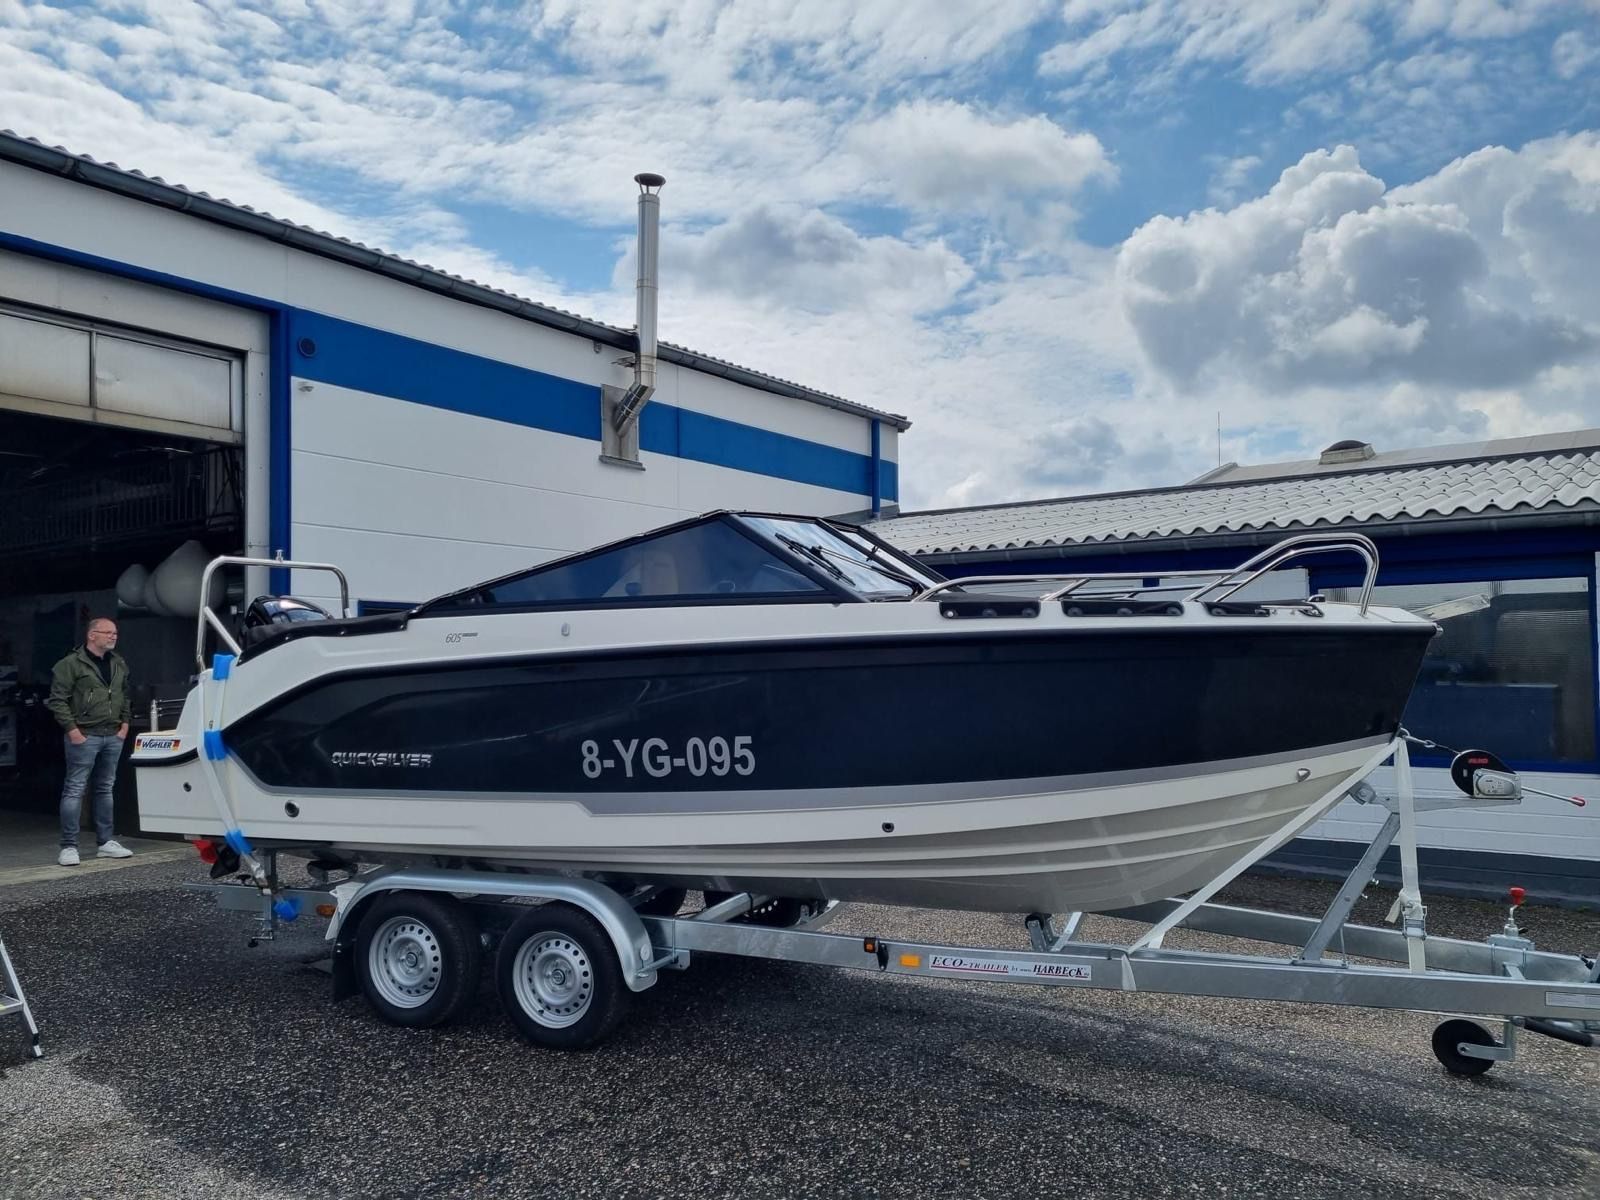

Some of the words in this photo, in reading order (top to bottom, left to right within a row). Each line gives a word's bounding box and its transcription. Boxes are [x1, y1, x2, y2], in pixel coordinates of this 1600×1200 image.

[445, 632, 462, 643] 605
[331, 752, 432, 768] QUICKSILVER
[581, 735, 756, 779] 8-YG-095
[1033, 964, 1083, 978] HARBECK
